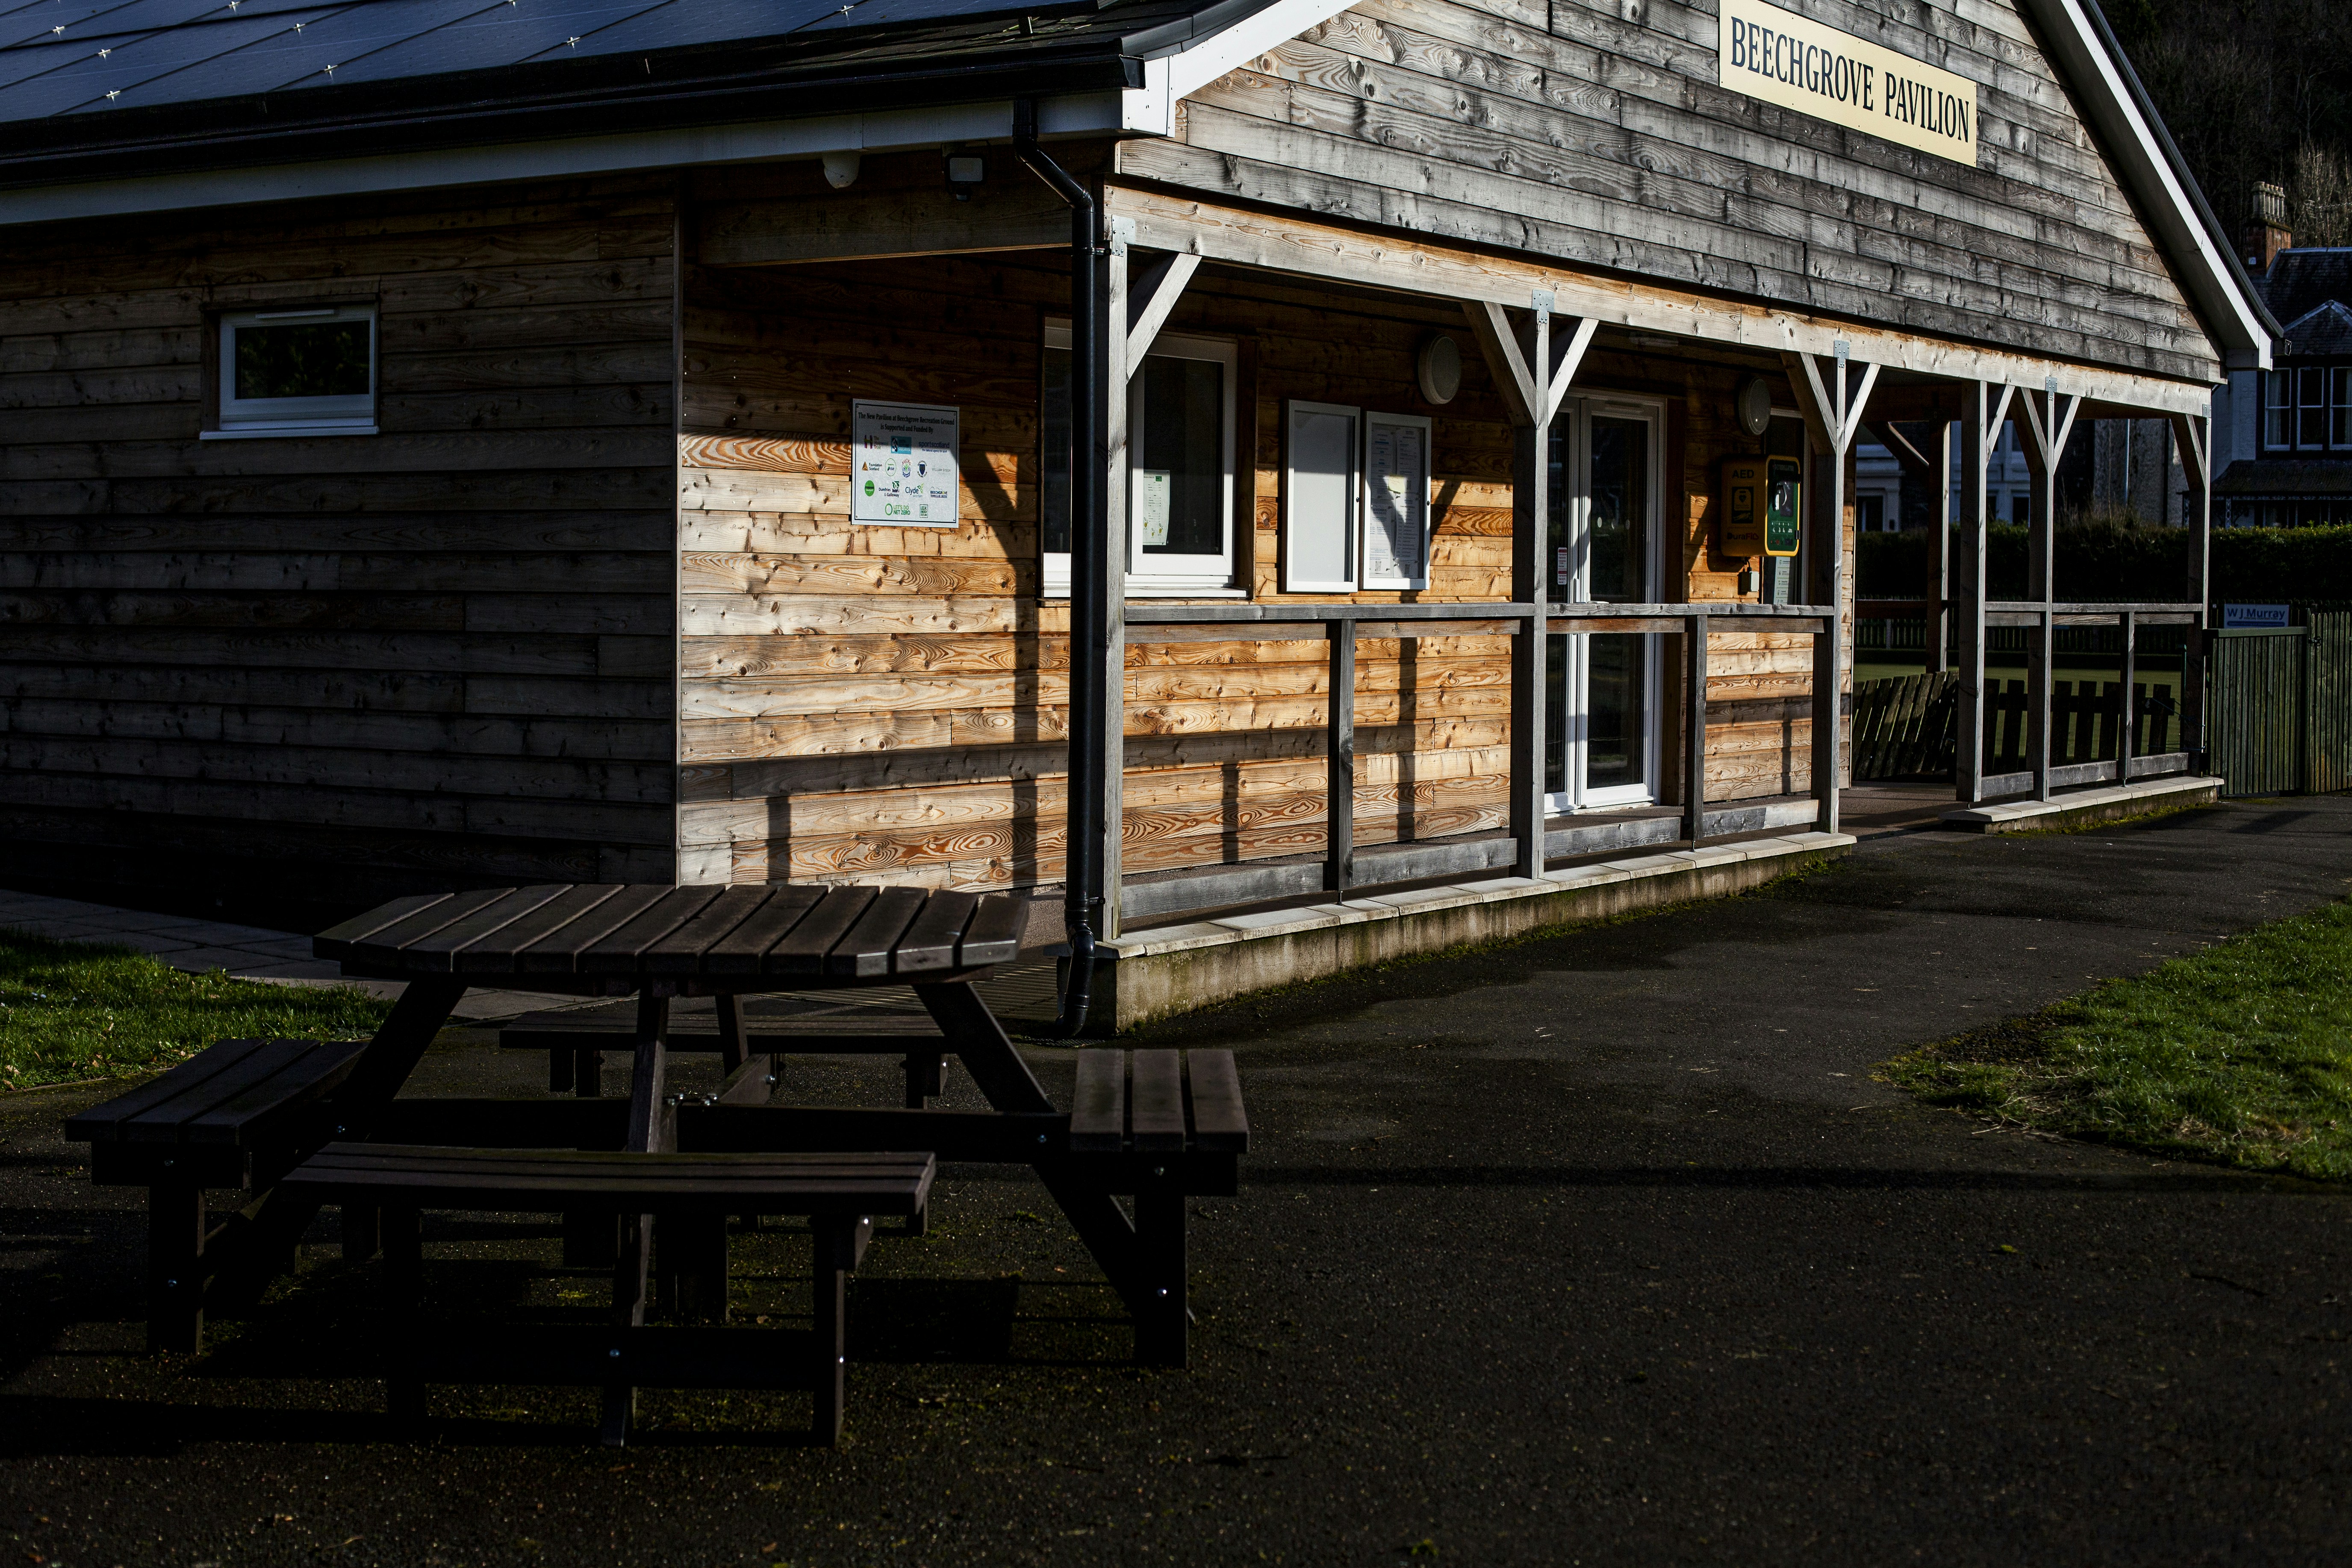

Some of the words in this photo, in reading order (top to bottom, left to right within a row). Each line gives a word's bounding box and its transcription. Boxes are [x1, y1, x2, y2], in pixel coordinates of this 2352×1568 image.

[1731, 16, 1874, 112] BEECHGROVE
[1884, 71, 1969, 143] PAVILION
[897, 415, 919, 424] Beechgrove
[885, 424, 905, 432] Supported
[1732, 469, 1754, 479] AED
[905, 486, 919, 495] Clyde
[2228, 608, 2238, 617] W
[2239, 608, 2243, 619] J
[2247, 608, 2286, 620] Murray
